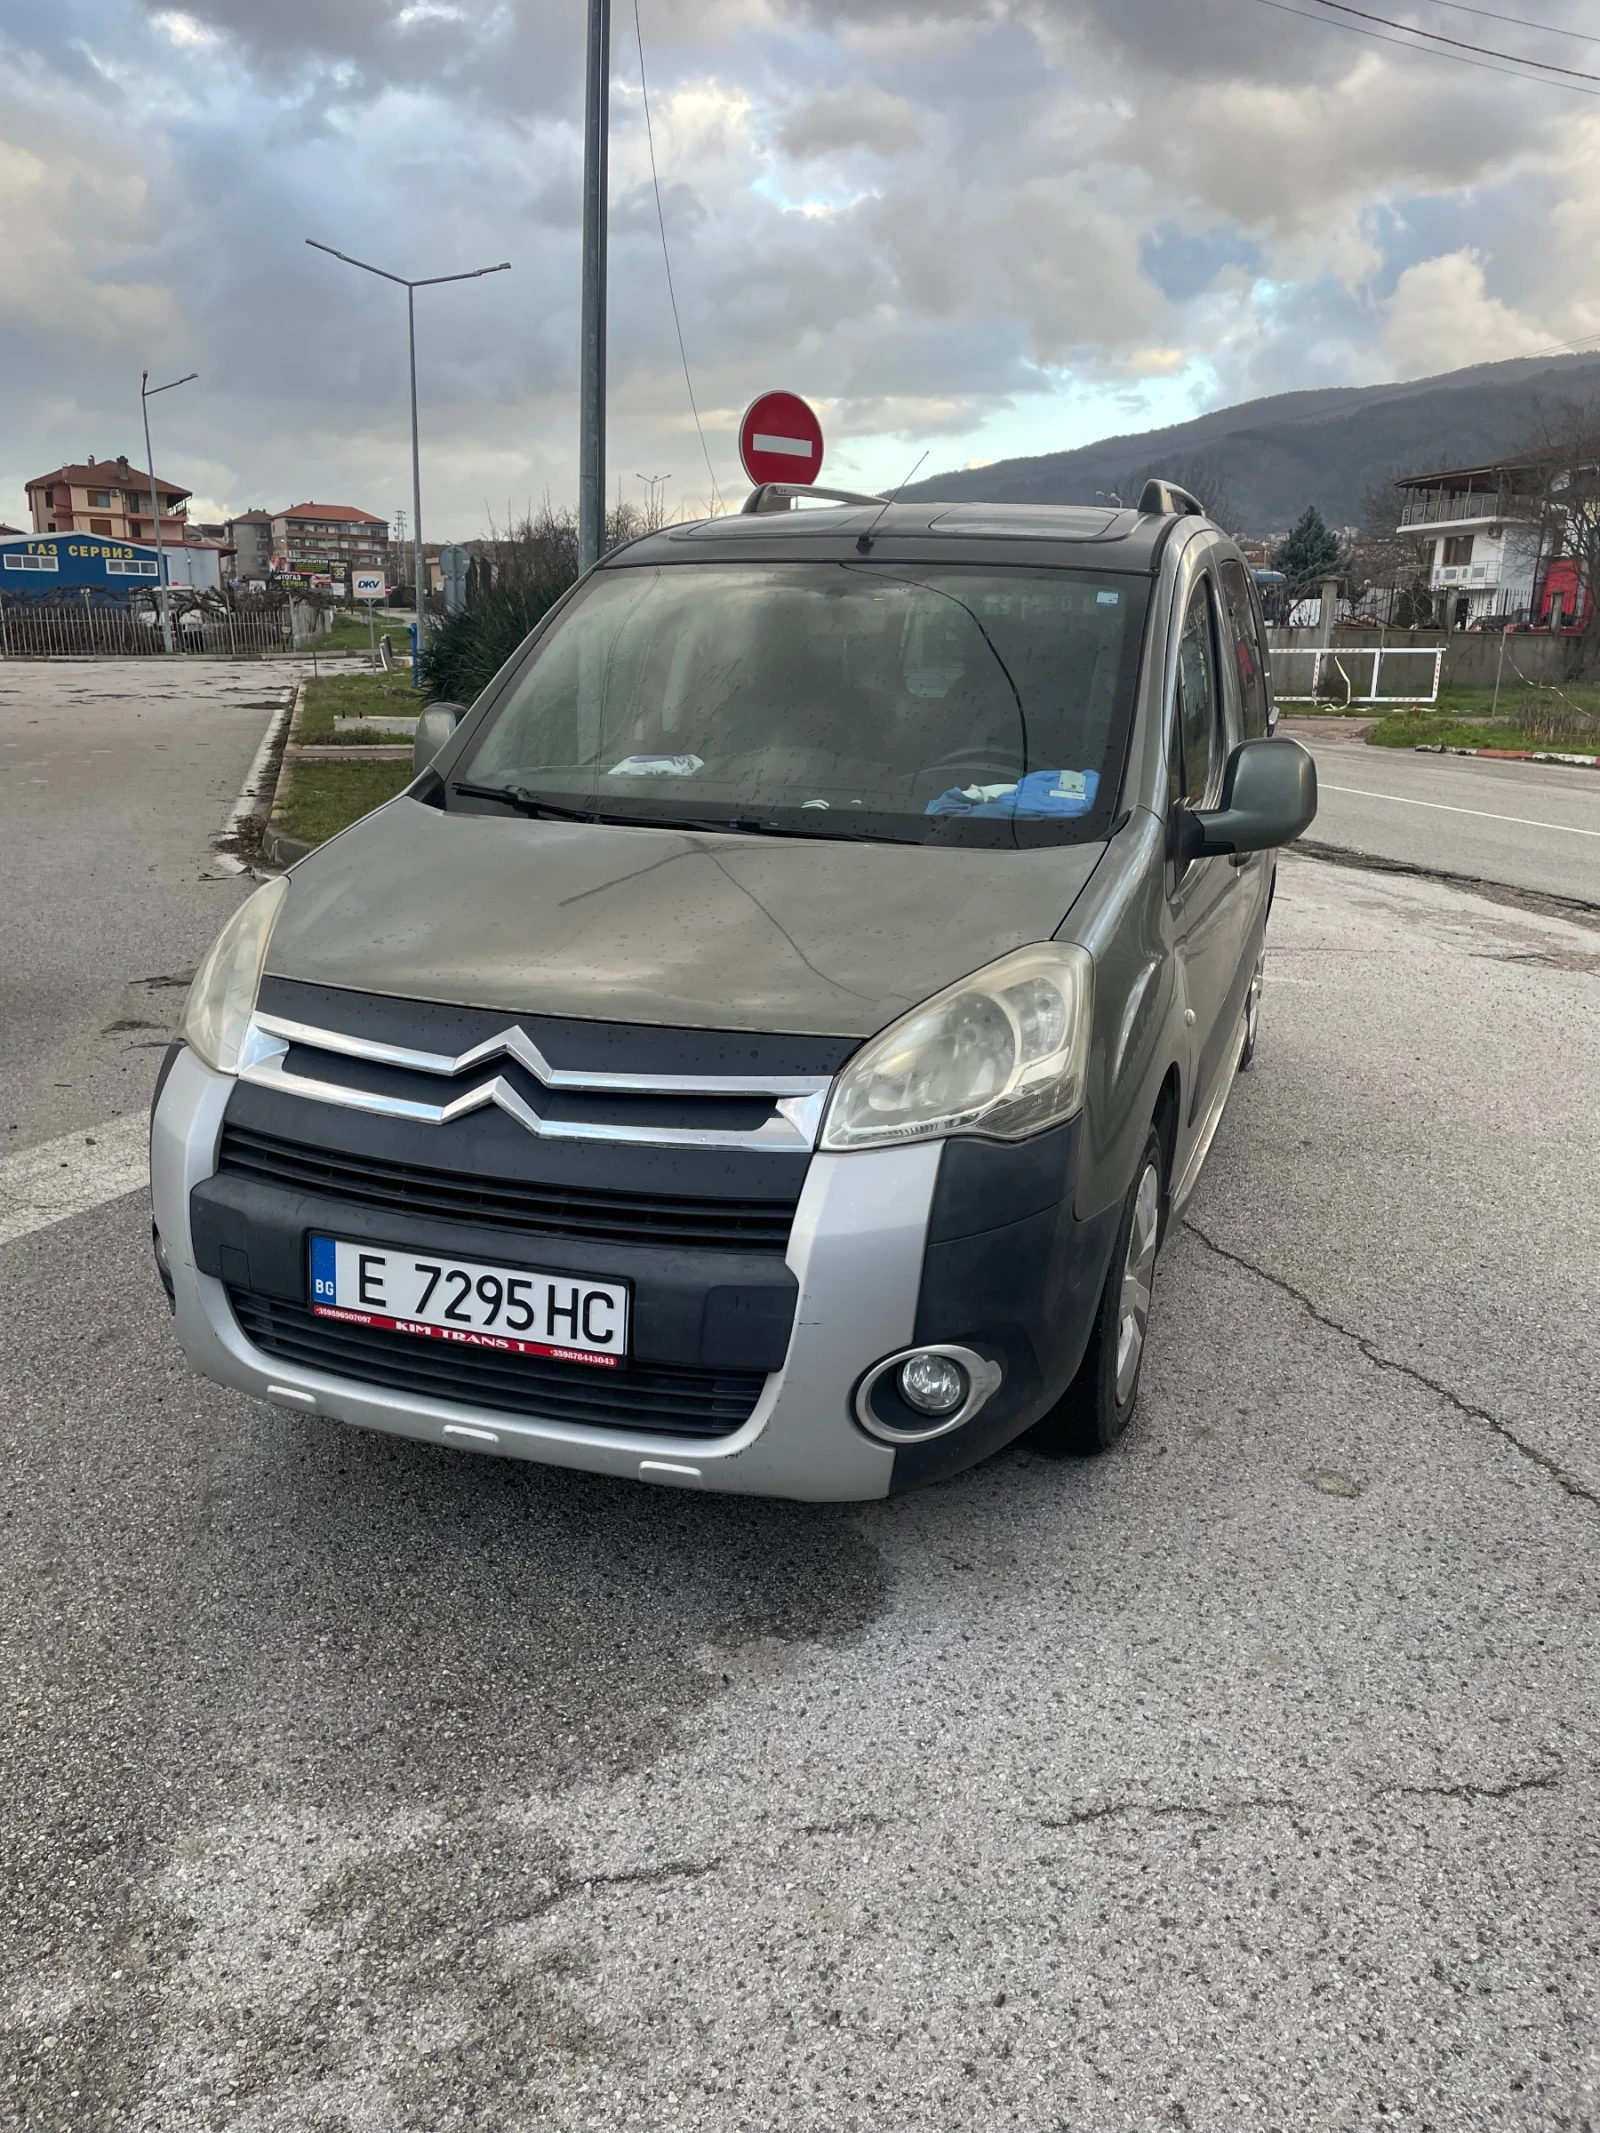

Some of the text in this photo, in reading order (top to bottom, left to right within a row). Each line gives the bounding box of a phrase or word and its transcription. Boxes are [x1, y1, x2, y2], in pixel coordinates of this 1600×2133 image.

[27, 543, 134, 559] ГАЗ СЕРВИЗ
[357, 580, 380, 588] DKV
[315, 1278, 334, 1296] BG
[358, 1253, 387, 1308] E
[414, 1263, 535, 1331] 7295
[395, 1321, 431, 1335] KIM
[438, 1328, 509, 1349] TRANS
